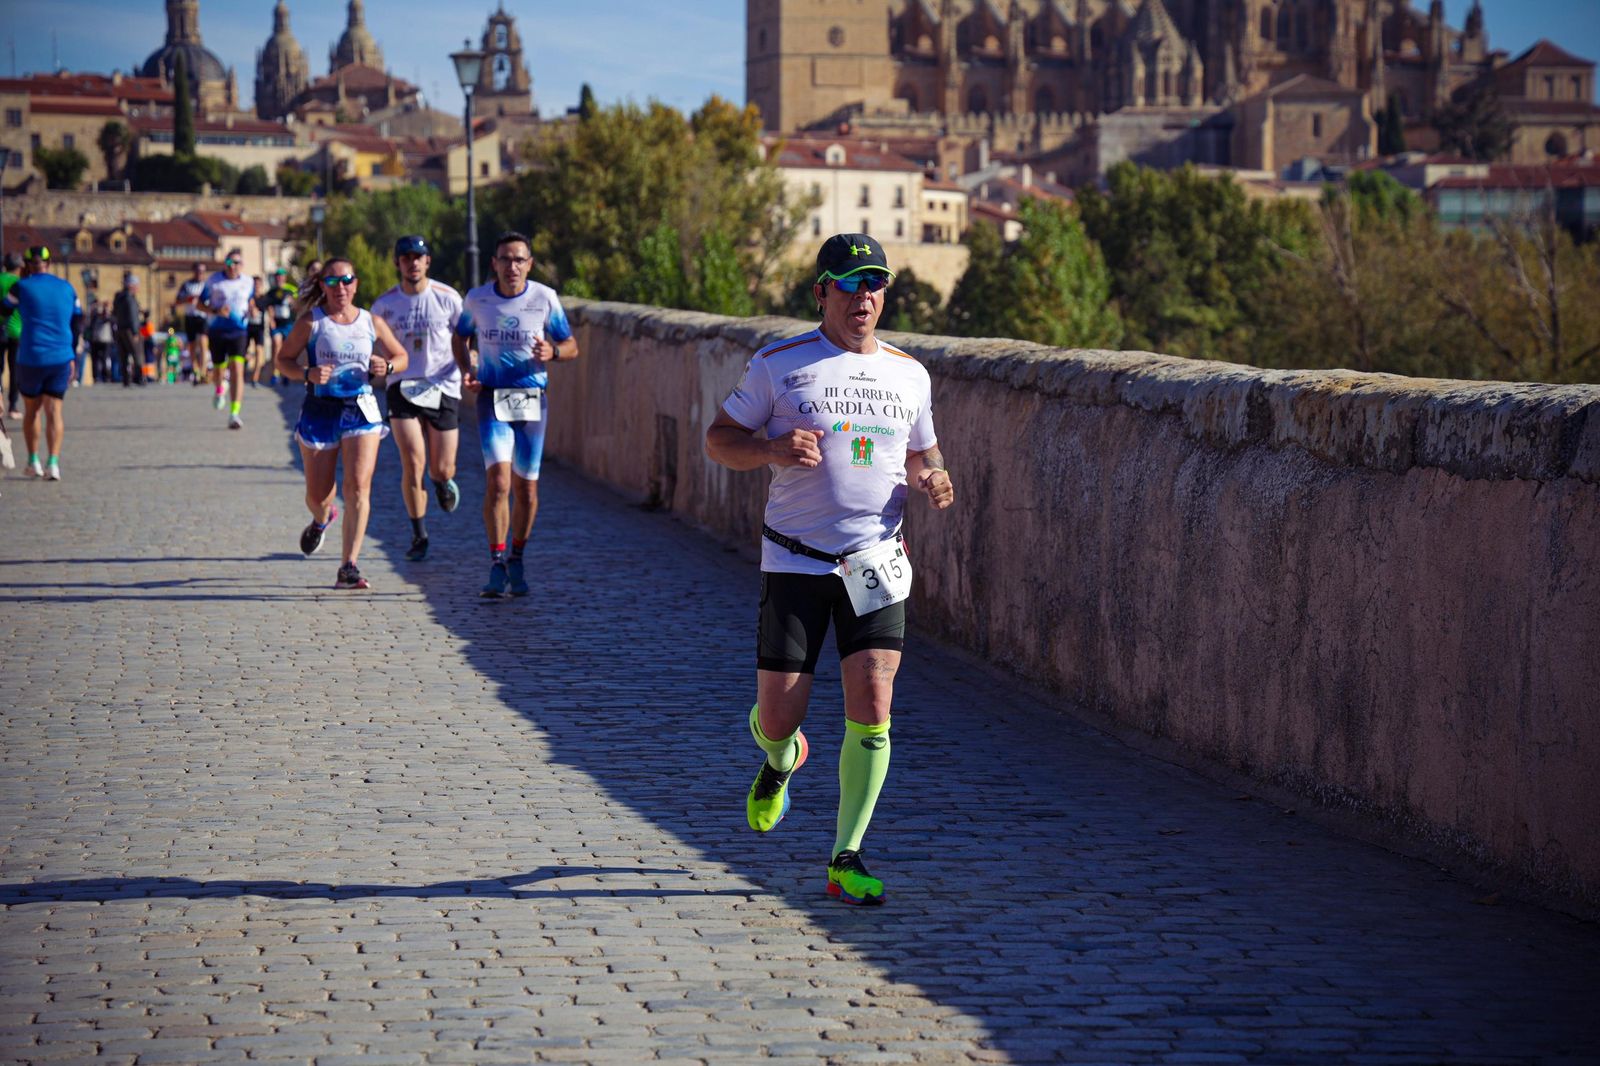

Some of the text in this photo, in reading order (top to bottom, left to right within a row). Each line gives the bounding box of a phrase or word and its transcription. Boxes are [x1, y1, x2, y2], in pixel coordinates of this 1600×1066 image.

[319, 350, 368, 360] INFINITY
[824, 386, 902, 403] III CARRERA
[504, 398, 529, 410] 122
[798, 400, 876, 416] GVARDIA
[852, 423, 895, 436] Iberdrola
[862, 558, 903, 590] 315
